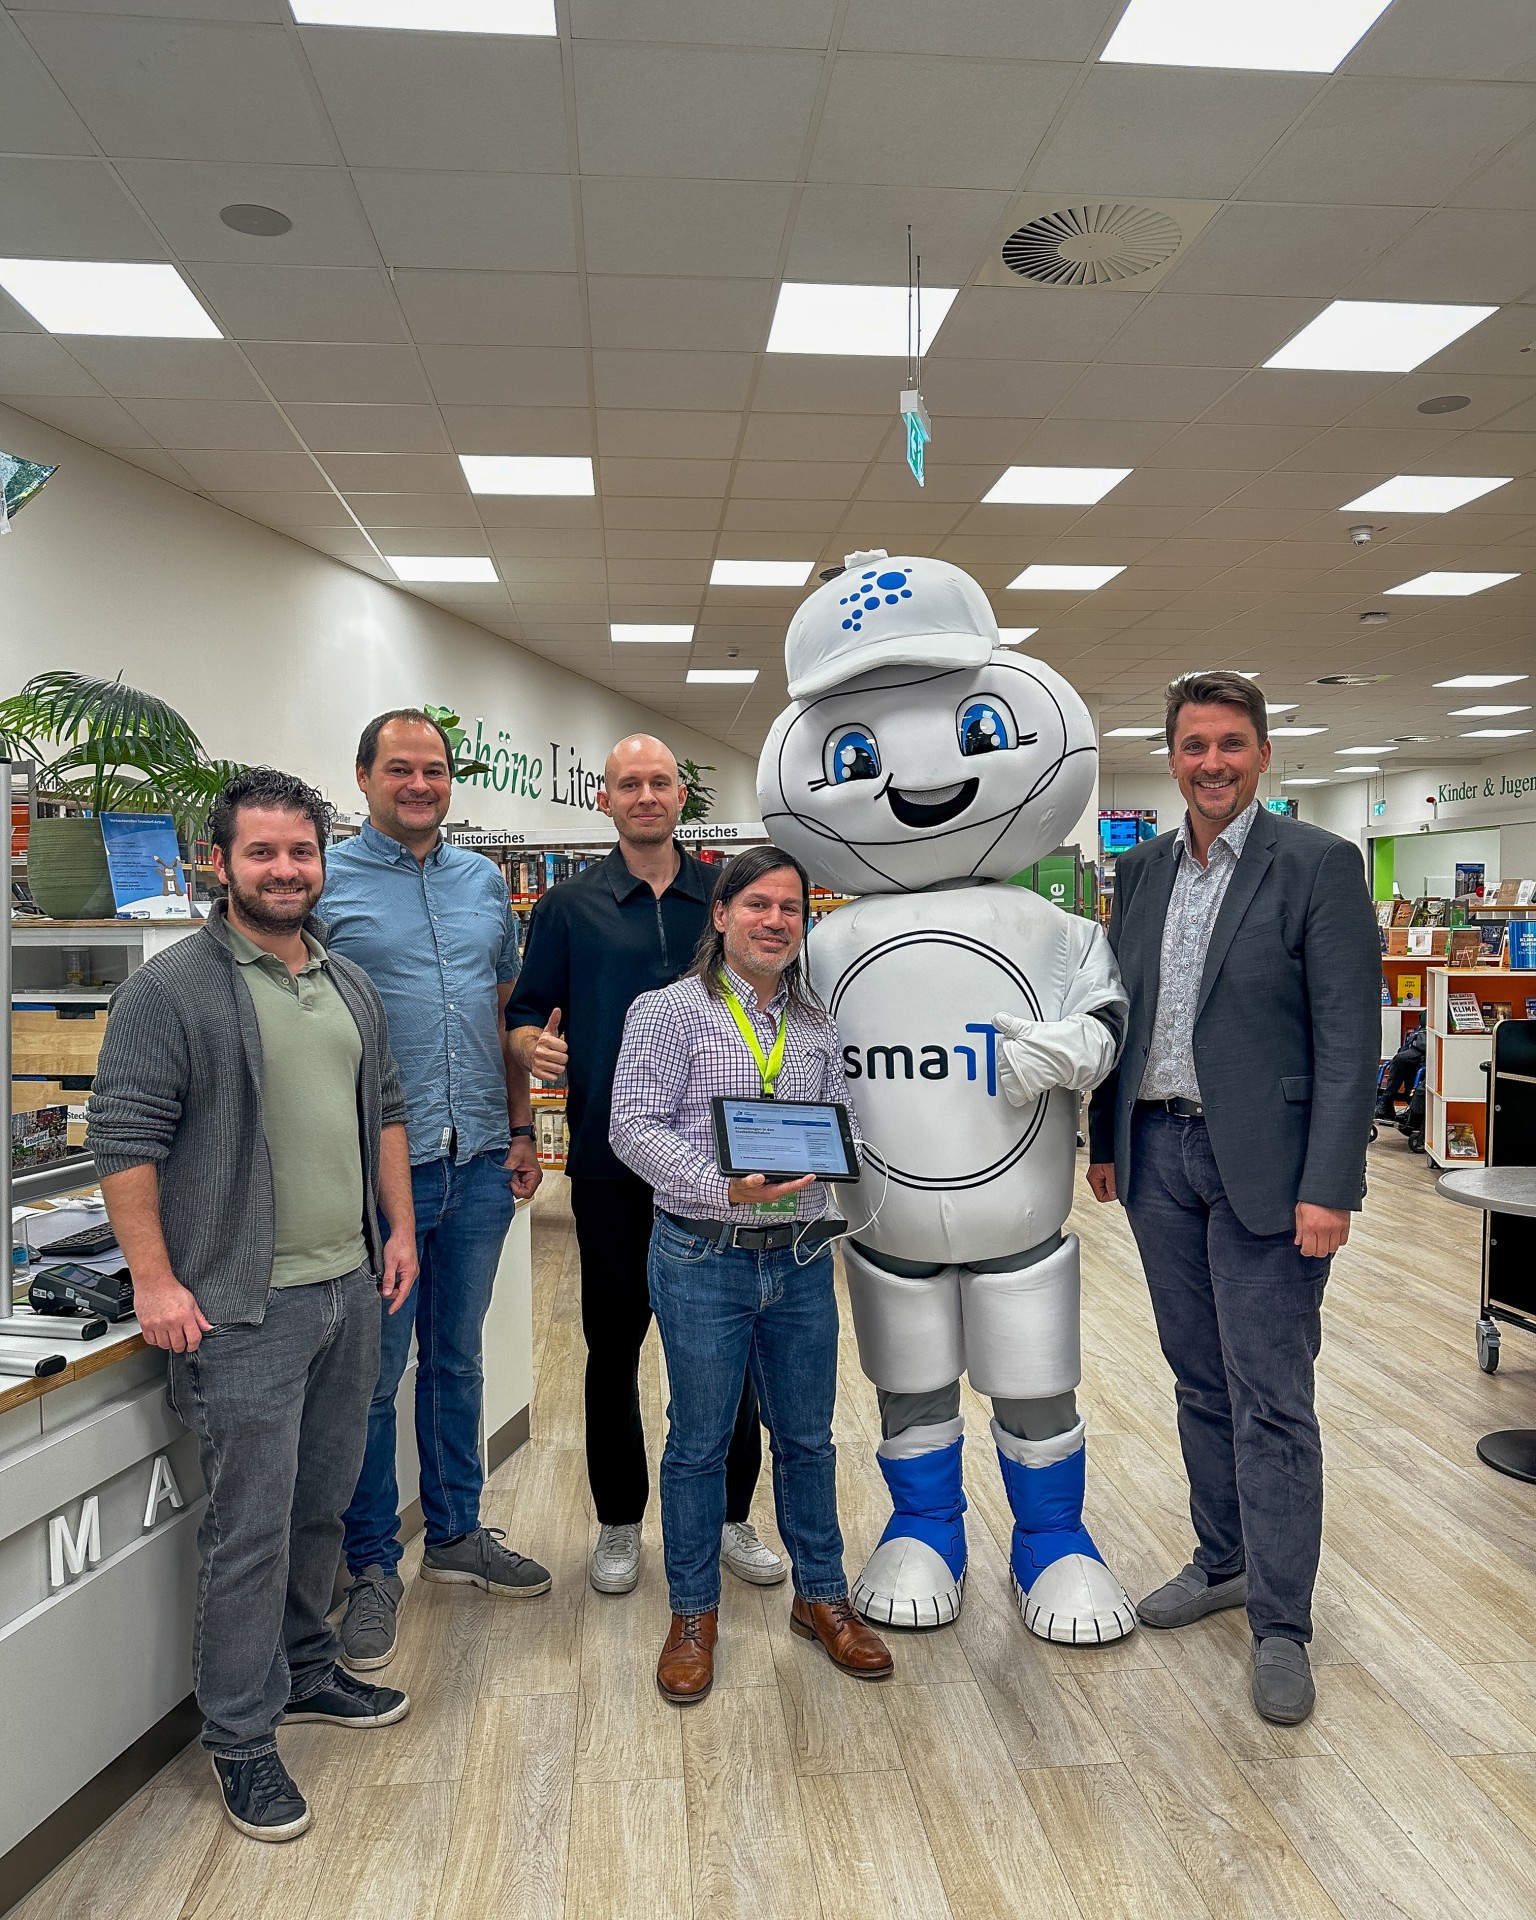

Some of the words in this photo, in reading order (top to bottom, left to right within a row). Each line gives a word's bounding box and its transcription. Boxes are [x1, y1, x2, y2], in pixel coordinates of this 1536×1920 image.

[440, 706, 543, 799] chöne
[1438, 781, 1478, 803] Kinder
[1483, 777, 1496, 798] &
[452, 832, 525, 846] Historisches
[1452, 1005, 1477, 1013] KLIMA
